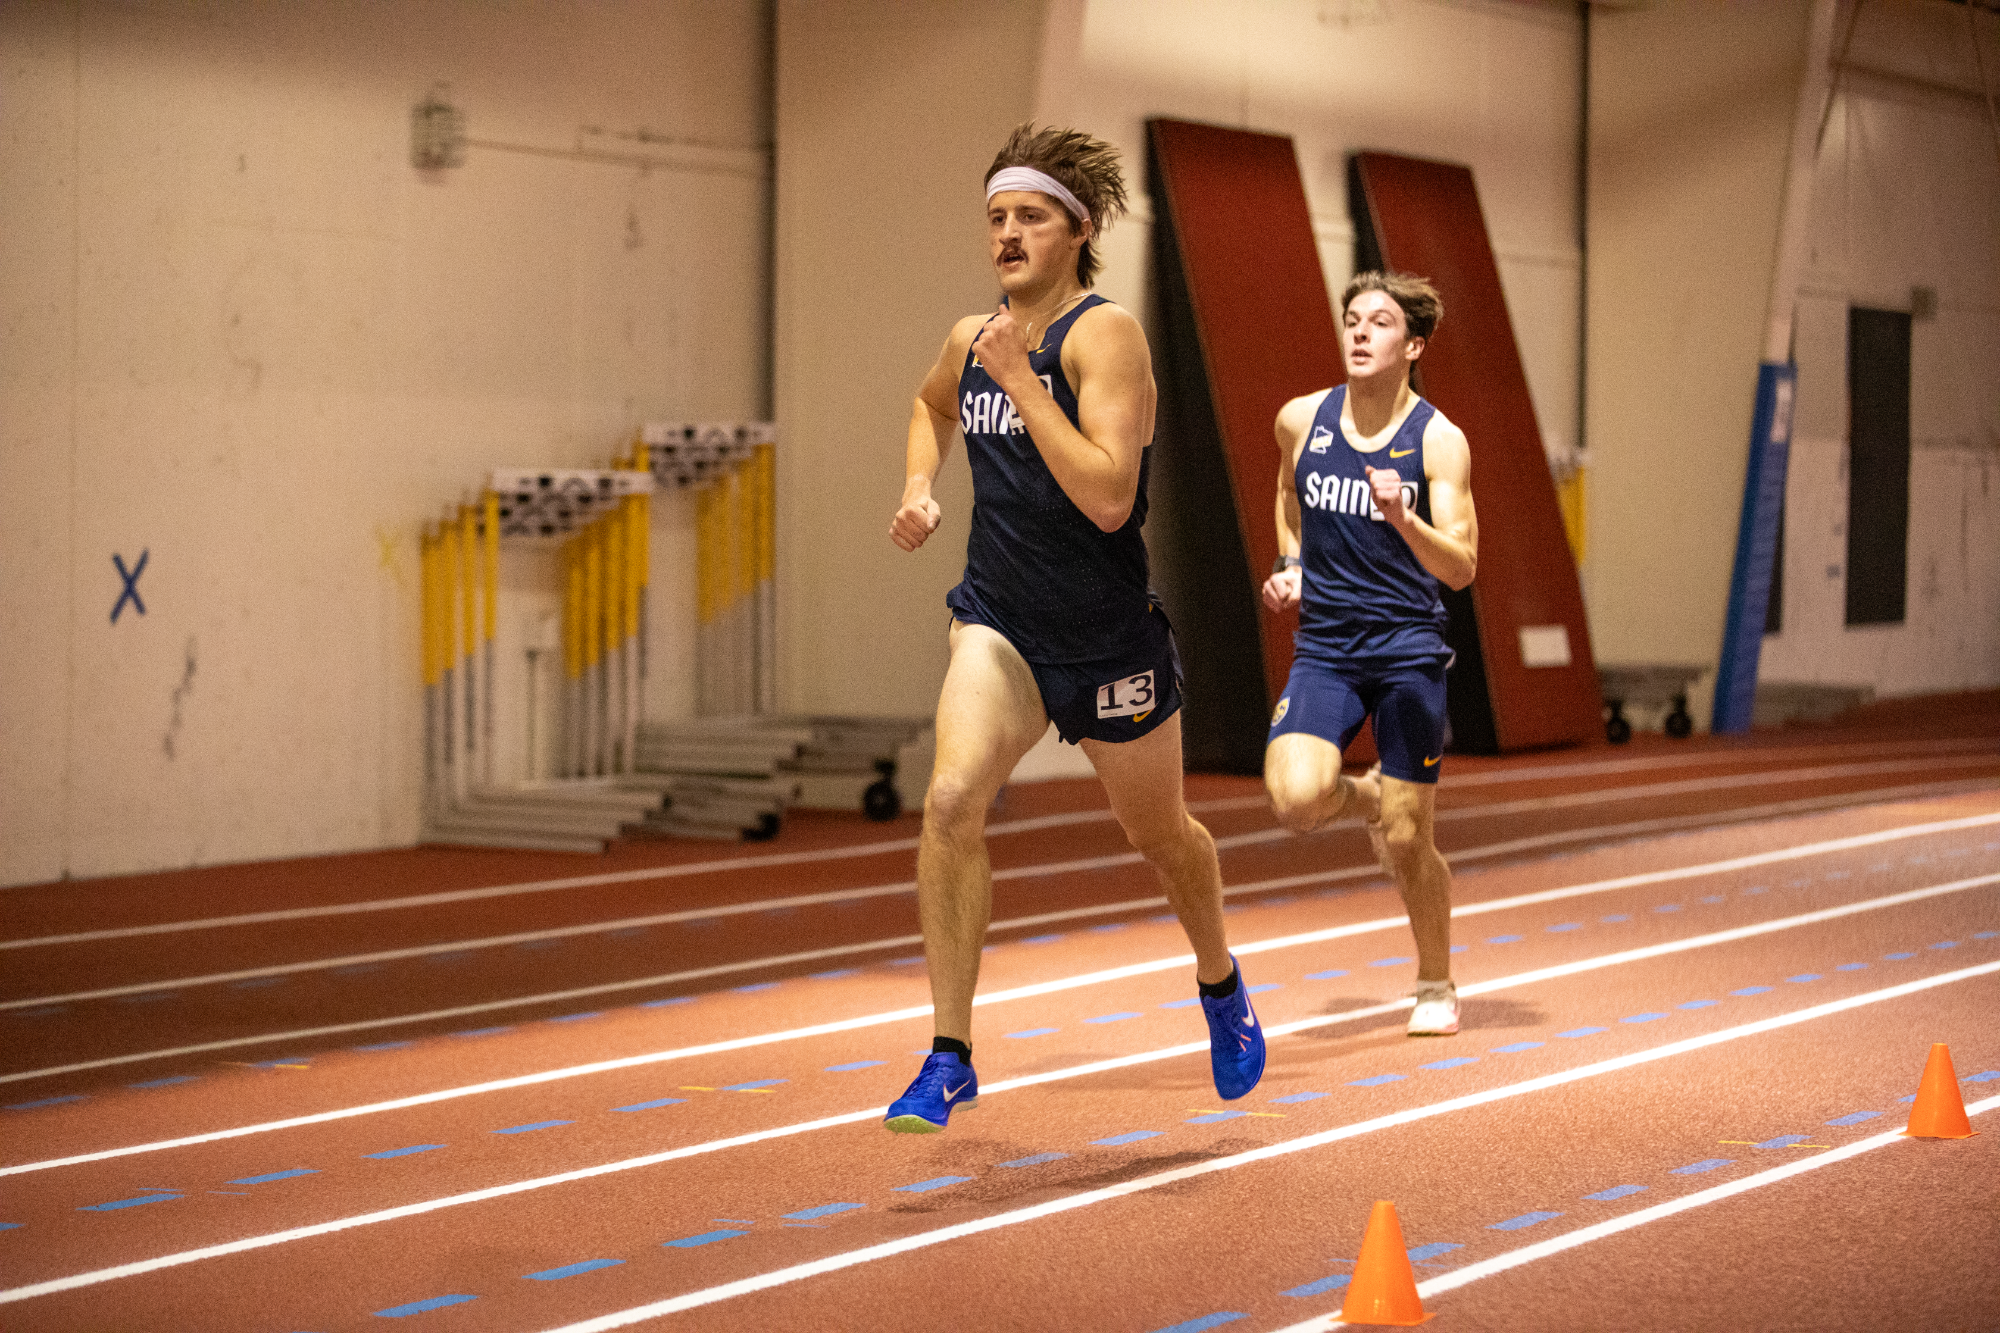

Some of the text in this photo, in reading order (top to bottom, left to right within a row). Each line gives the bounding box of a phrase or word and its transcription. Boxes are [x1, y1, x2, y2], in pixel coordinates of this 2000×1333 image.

[961, 391, 1024, 435] SAIN
[1304, 471, 1371, 517] SAIN
[1100, 674, 1153, 711] 13
